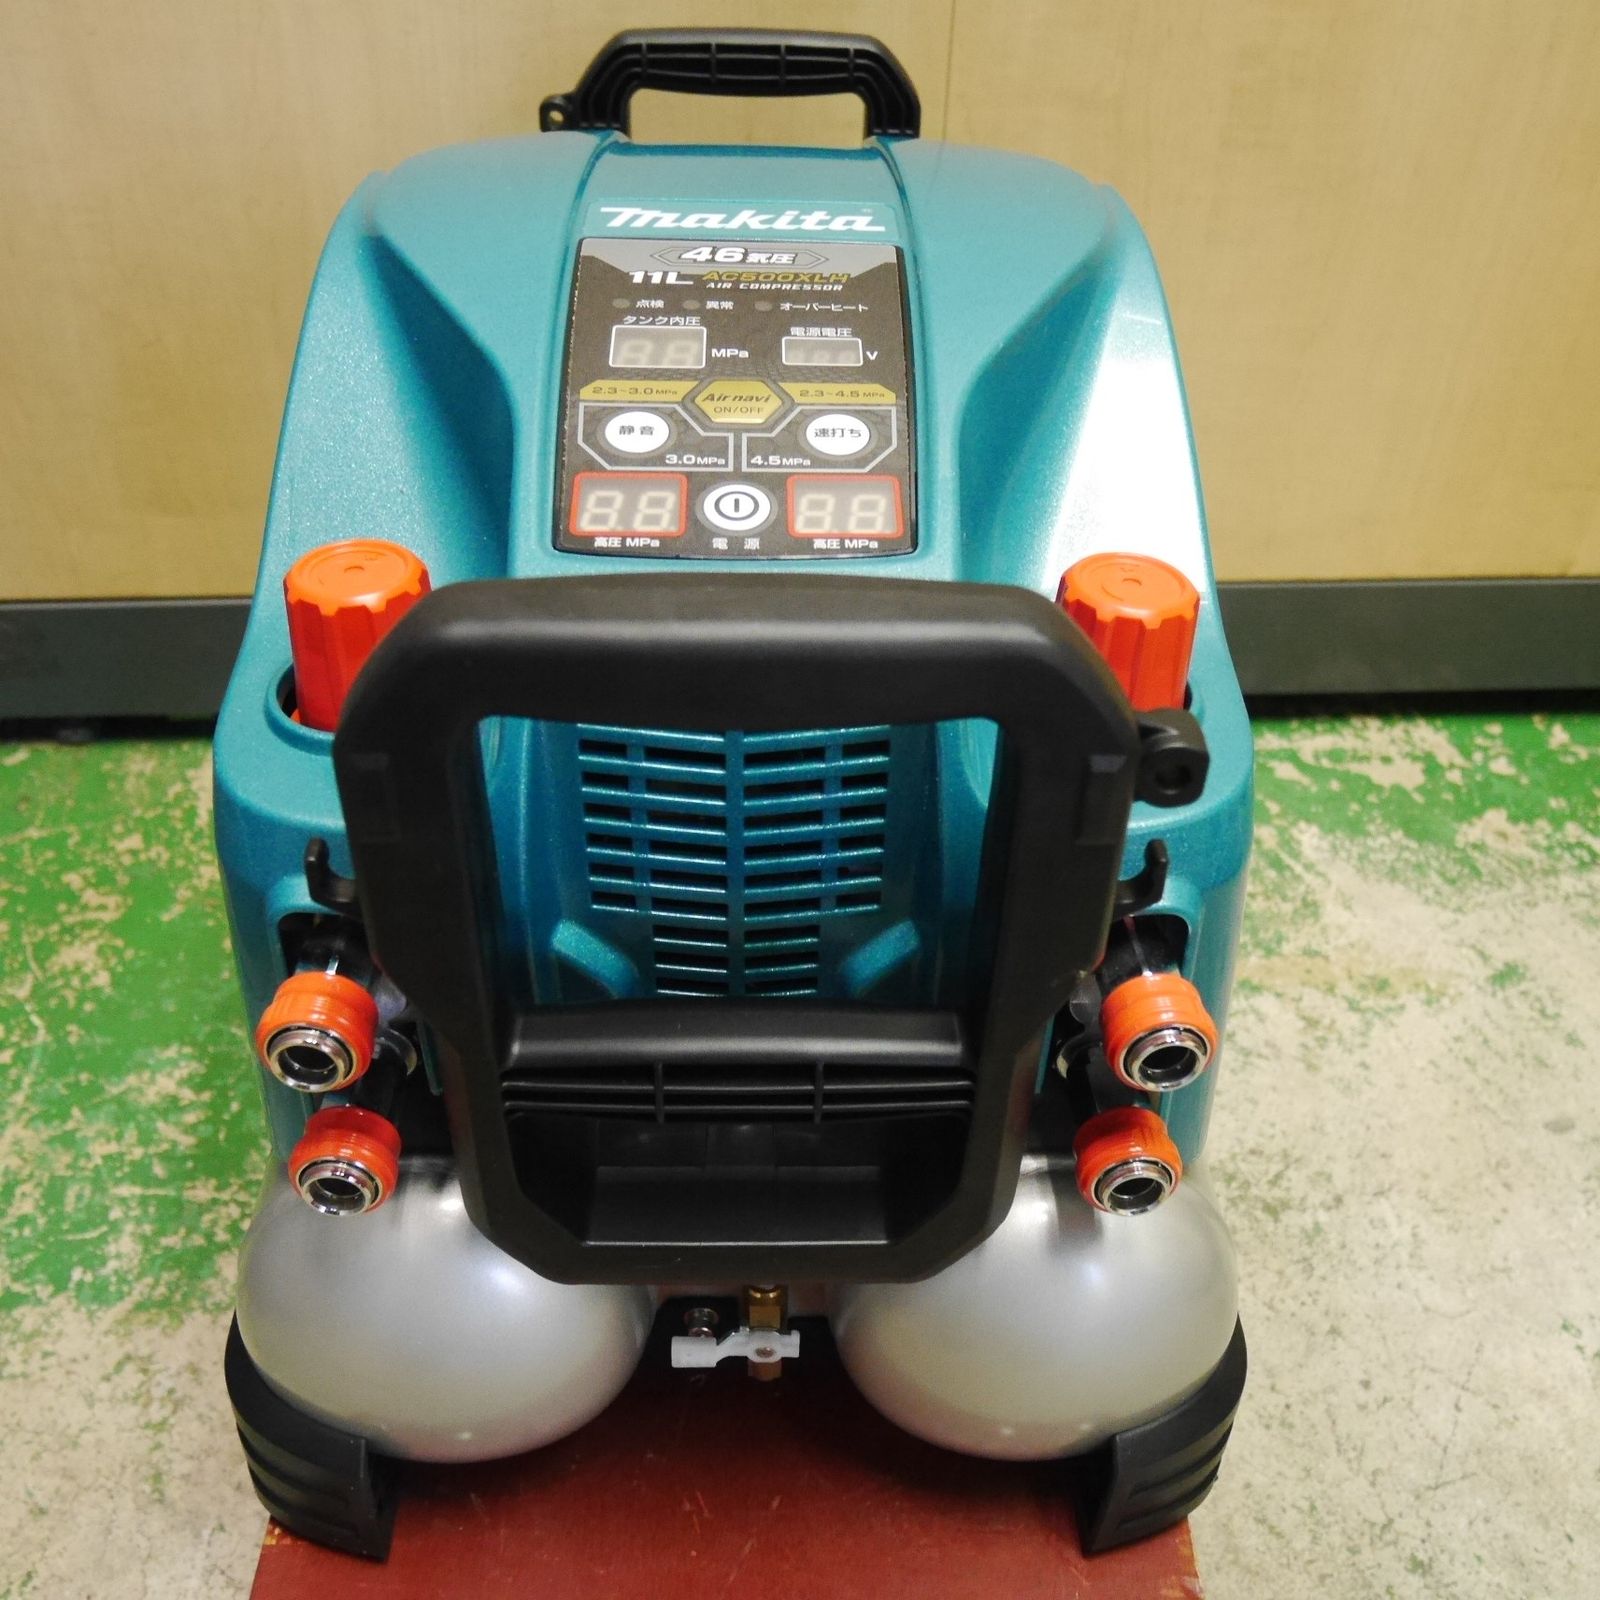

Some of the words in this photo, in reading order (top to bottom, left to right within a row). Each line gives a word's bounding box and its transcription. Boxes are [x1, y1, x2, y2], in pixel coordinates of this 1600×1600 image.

[629, 271, 693, 285] 11L
[702, 271, 850, 283] AC500XLH
[739, 283, 843, 291] COMPRESSOR
[636, 299, 664, 309] 点検
[706, 300, 734, 310] 異常
[780, 302, 868, 312] オーバーヒート
[623, 316, 701, 326] タンク内圧
[790, 328, 852, 337] 電源電圧
[712, 348, 749, 358] MPa
[867, 351, 878, 360] V
[713, 406, 764, 414] ON/OFF
[814, 428, 862, 438] 速打ち
[594, 538, 622, 547] 高圧
[626, 538, 660, 547] MPa
[813, 539, 841, 548] 高圧
[844, 540, 878, 548] MPa
